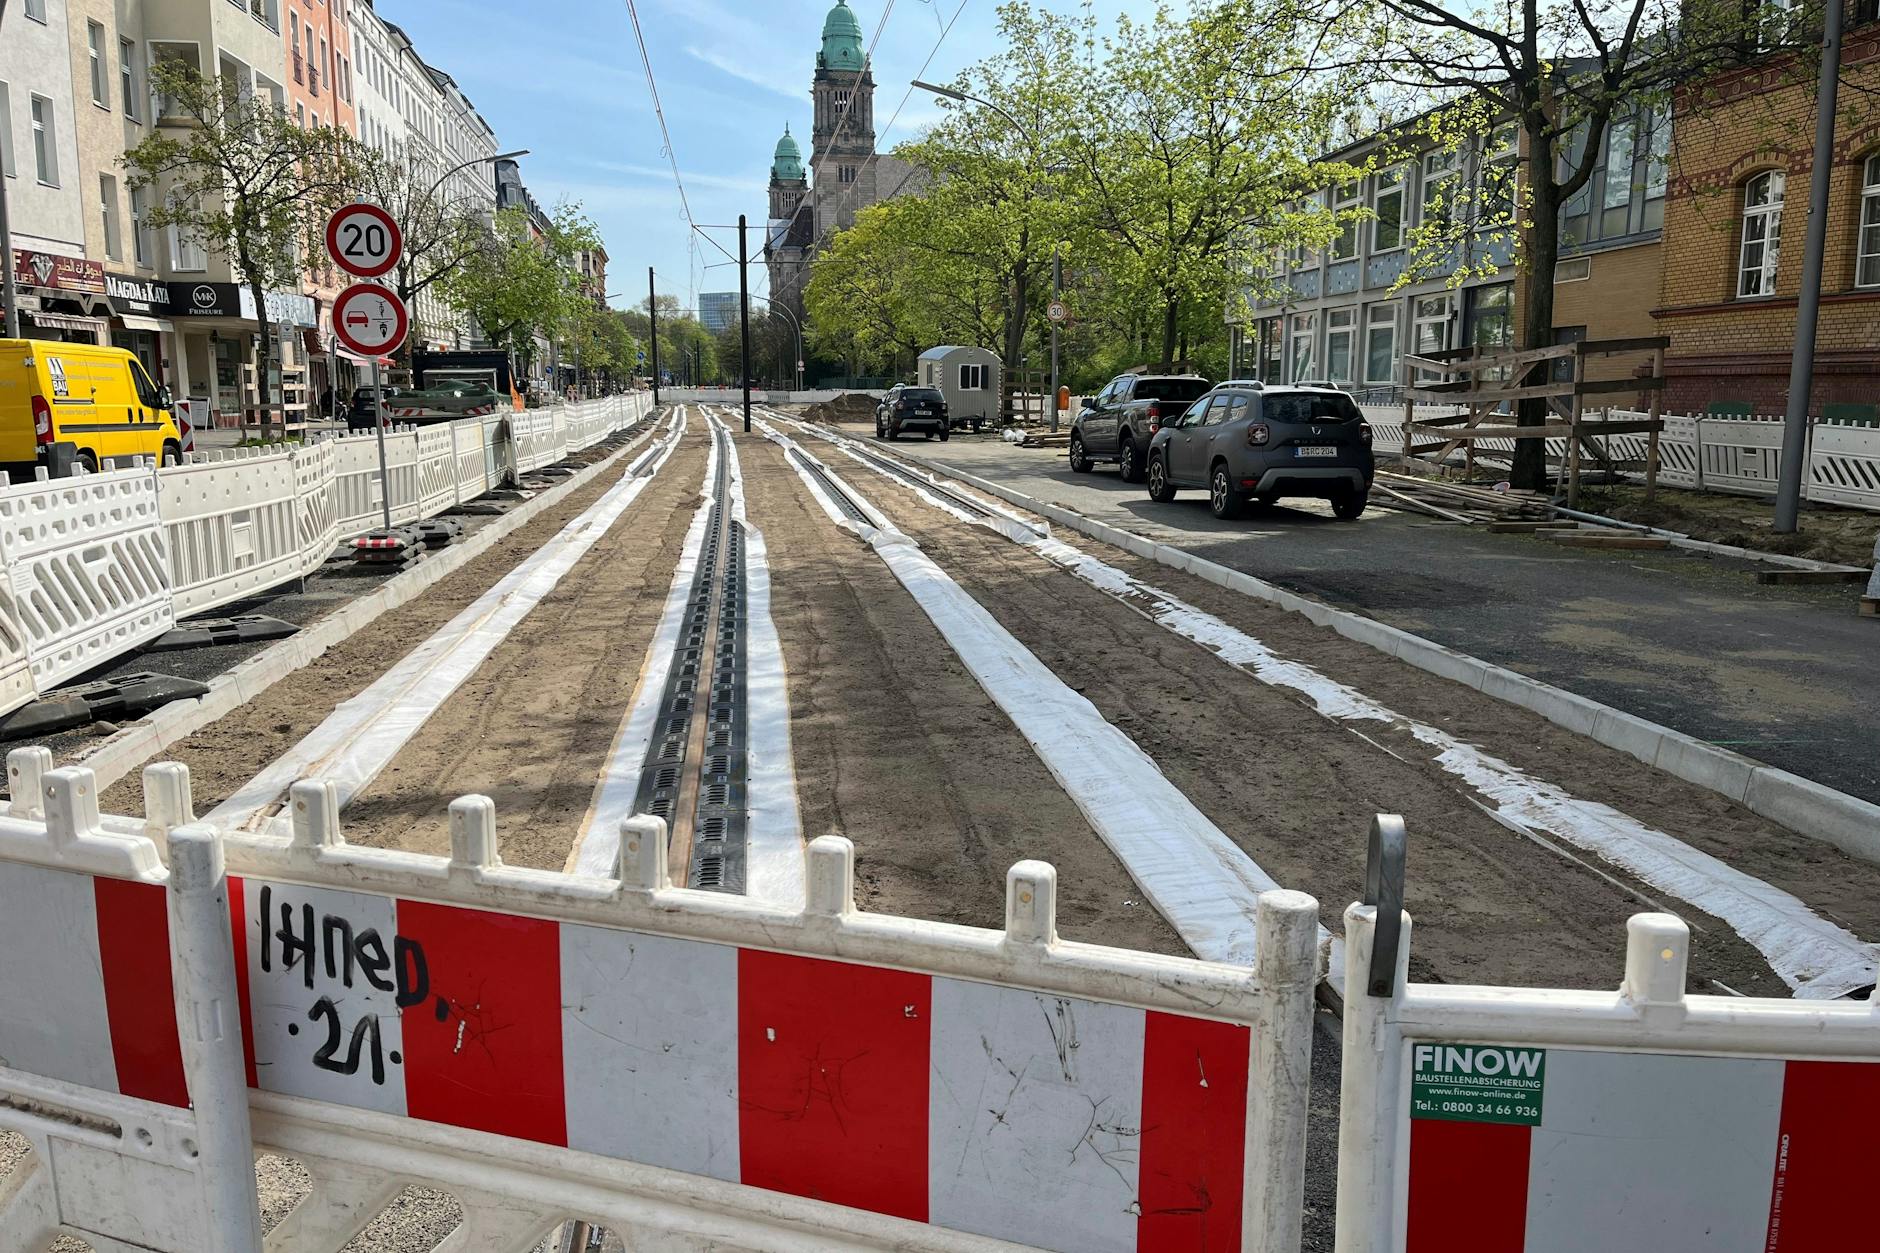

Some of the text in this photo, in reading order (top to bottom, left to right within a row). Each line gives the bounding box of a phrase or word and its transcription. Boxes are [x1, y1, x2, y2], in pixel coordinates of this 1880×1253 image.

[343, 223, 386, 257] 20
[1051, 307, 1062, 317] 30
[52, 380, 68, 392] BAU
[1415, 1045, 1543, 1078] FINOW
[1415, 1073, 1541, 1089] BAUSTELLENABSICHERUNG
[1428, 1087, 1527, 1100] www.finow-online.de
[1415, 1100, 1538, 1117] Tel.: 0800 34 66 936
[1778, 1134, 1790, 1172] ORALITE
